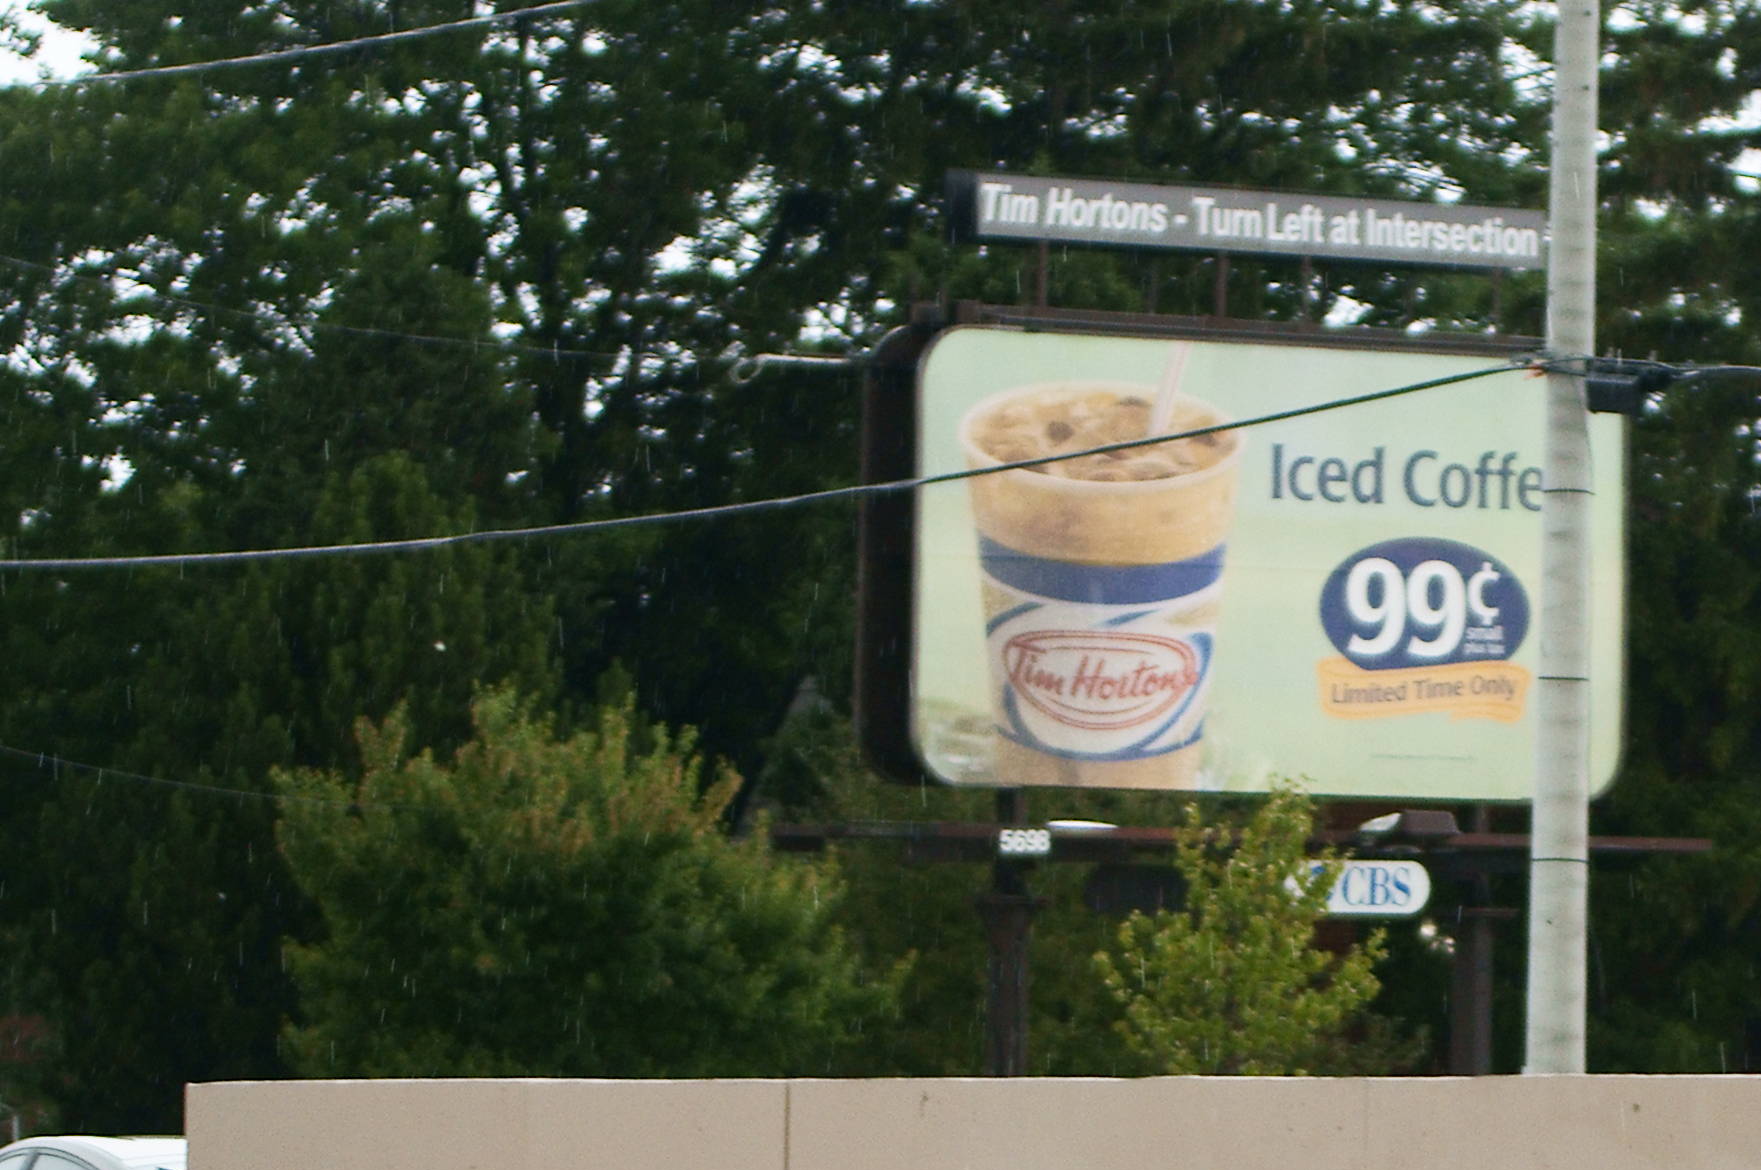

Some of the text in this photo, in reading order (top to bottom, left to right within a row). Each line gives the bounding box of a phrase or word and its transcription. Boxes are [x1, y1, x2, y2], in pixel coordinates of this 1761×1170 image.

[981, 182, 1039, 224] Tim
[1044, 186, 1169, 233] Hortons
[1193, 196, 1263, 239] Turn
[1267, 202, 1324, 243] Left
[1329, 208, 1358, 245] at
[1364, 207, 1538, 257] Intersection
[1271, 443, 1545, 512] Iced Coffe
[1345, 556, 1502, 657] 99¢
[1010, 642, 1065, 697] Tim
[1331, 675, 1517, 704] Limited Time Only
[1341, 865, 1411, 906] CBS
